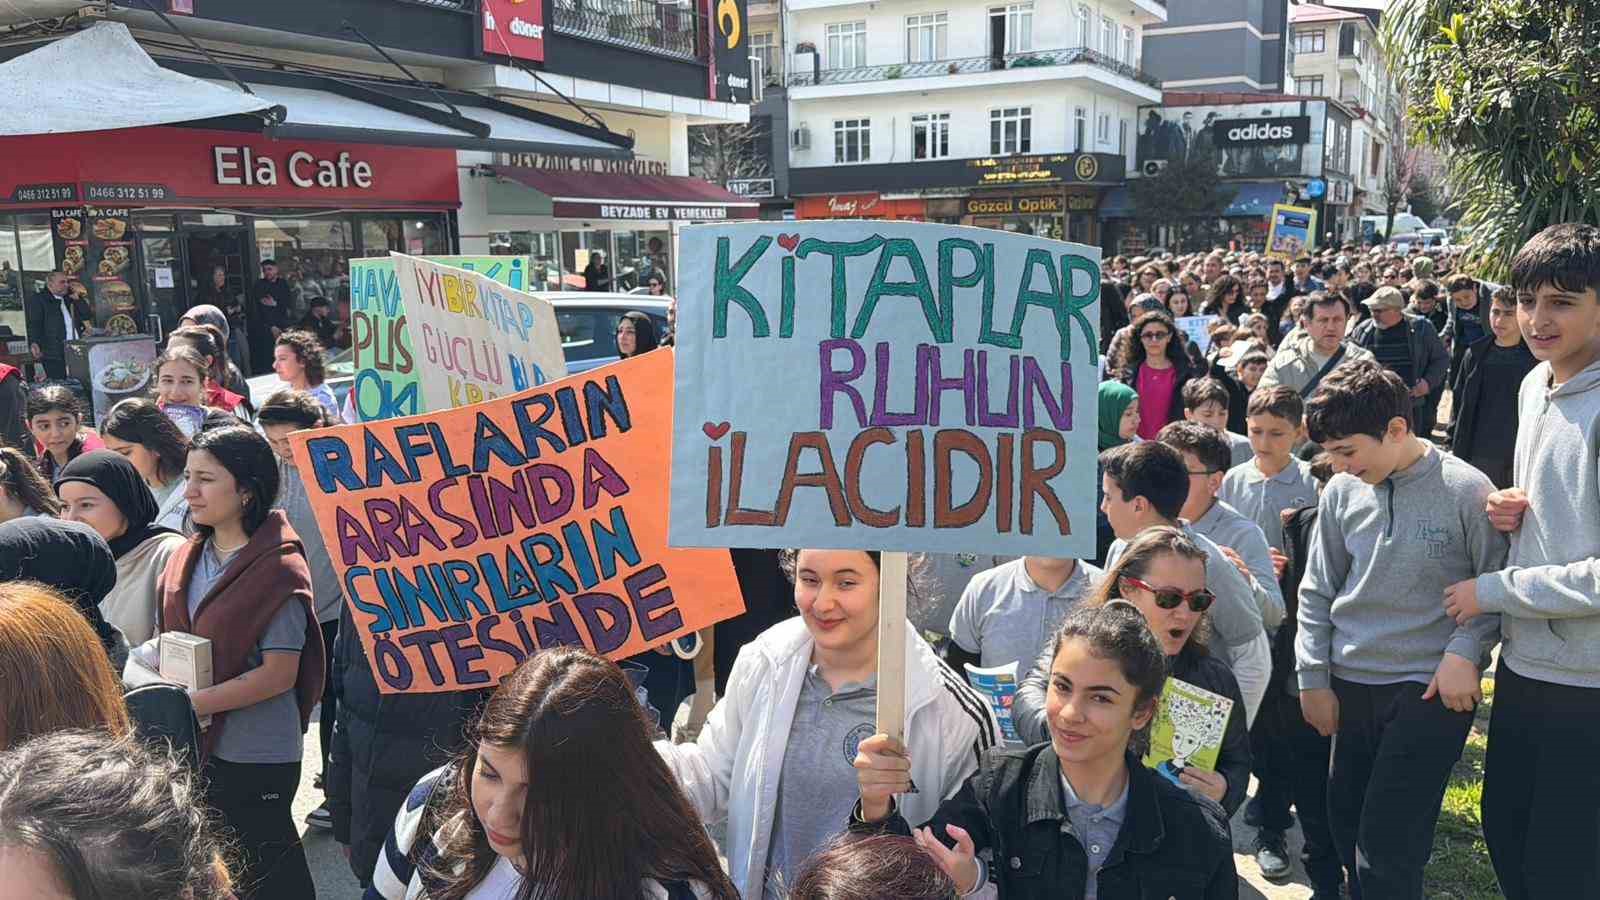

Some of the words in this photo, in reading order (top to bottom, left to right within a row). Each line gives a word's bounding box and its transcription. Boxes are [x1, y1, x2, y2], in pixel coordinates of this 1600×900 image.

[213, 145, 277, 186] Ela
[288, 151, 374, 189] Cafe
[1228, 123, 1294, 141] adidas
[37, 189, 50, 199] 312
[90, 188, 115, 198] 0466
[118, 188, 136, 198] 312
[138, 188, 149, 198] 51
[152, 188, 165, 199] 99
[600, 205, 650, 219] BEYZADE
[656, 207, 669, 219] EV
[674, 206, 727, 219] YEMEKLERİ
[1018, 197, 1057, 213] Optik
[351, 266, 402, 317] HAV
[712, 233, 1100, 366] KİTAPLAR
[819, 338, 1073, 431] RUHUN
[306, 374, 632, 493] RAFLARIN
[336, 447, 630, 565] ARASINDA
[702, 421, 1072, 536] İLACIDIR
[344, 505, 642, 634] SINIRLARIN
[373, 563, 684, 690] ÖTESİNDE
